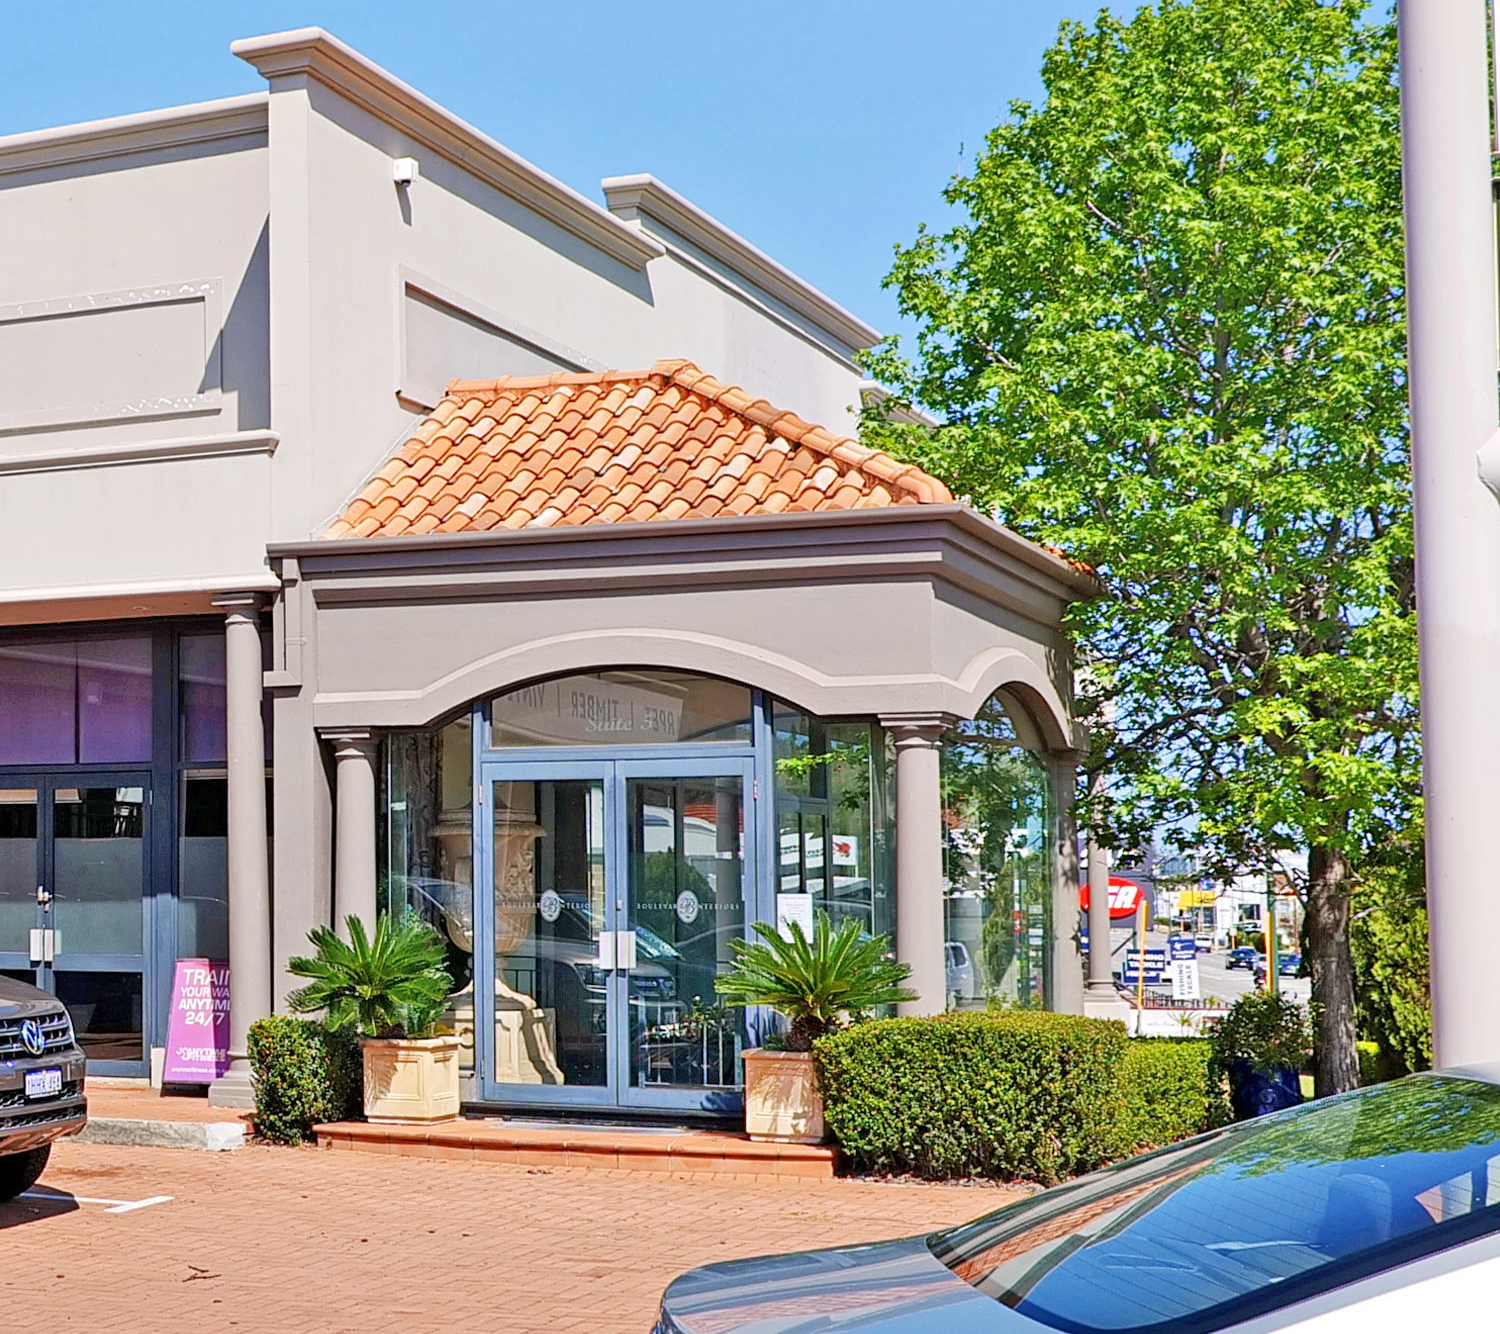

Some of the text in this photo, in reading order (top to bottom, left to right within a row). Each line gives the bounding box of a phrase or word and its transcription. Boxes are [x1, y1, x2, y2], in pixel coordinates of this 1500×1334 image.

[585, 717, 633, 732] Suite
[180, 986, 230, 997] YOUR WA
[184, 1011, 225, 1027] 24/7
